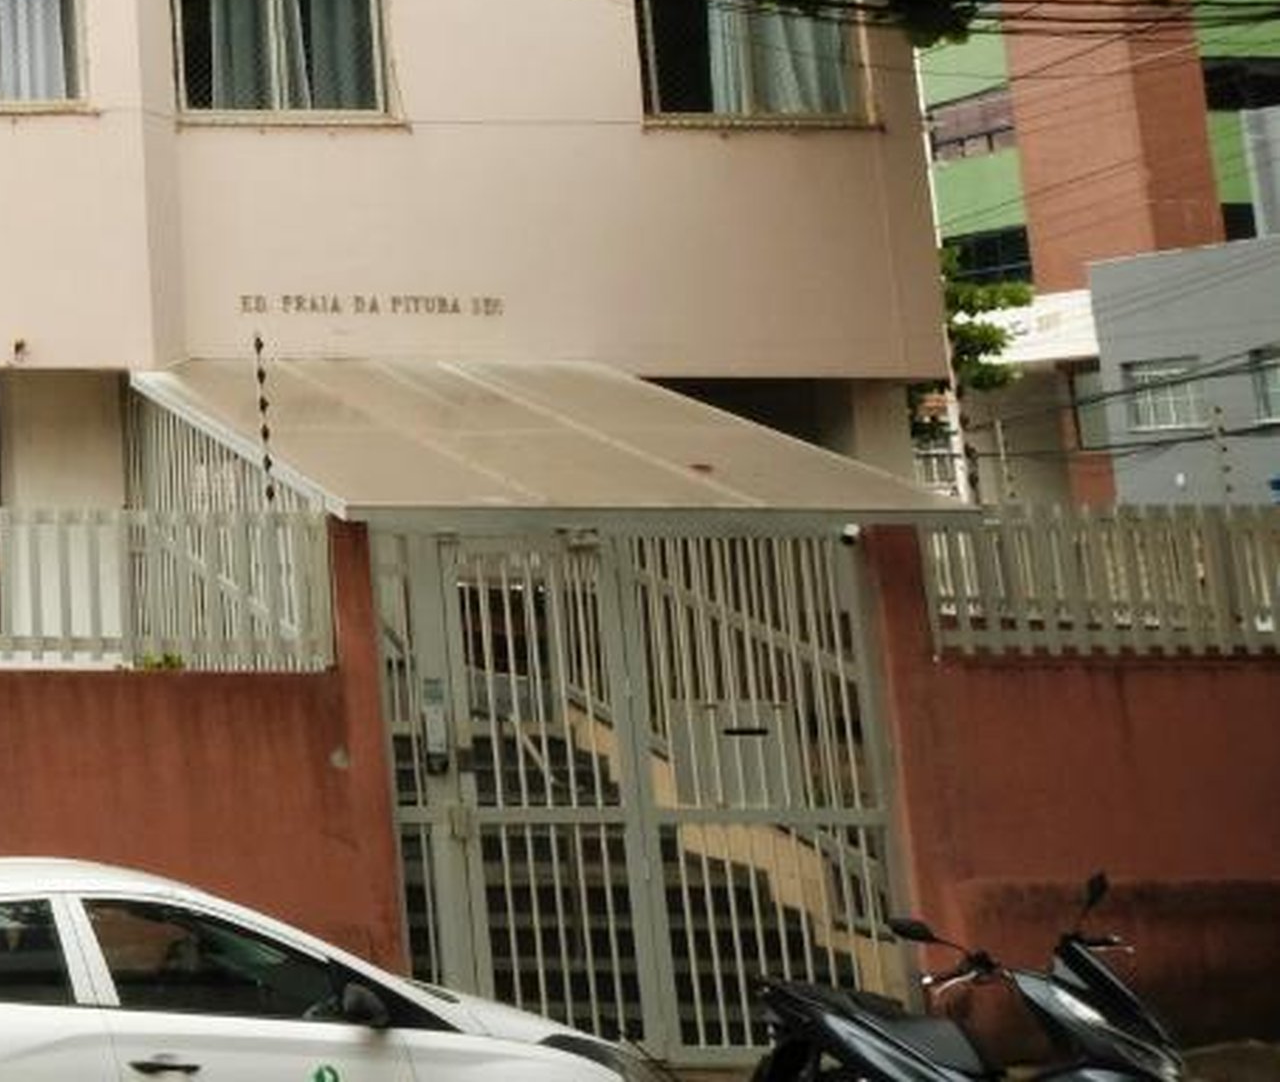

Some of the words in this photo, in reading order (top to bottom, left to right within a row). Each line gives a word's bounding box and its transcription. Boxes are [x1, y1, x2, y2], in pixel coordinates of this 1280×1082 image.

[282, 294, 342, 314] PRAIA
[353, 294, 380, 314] DA
[391, 295, 461, 314] PITUBA
